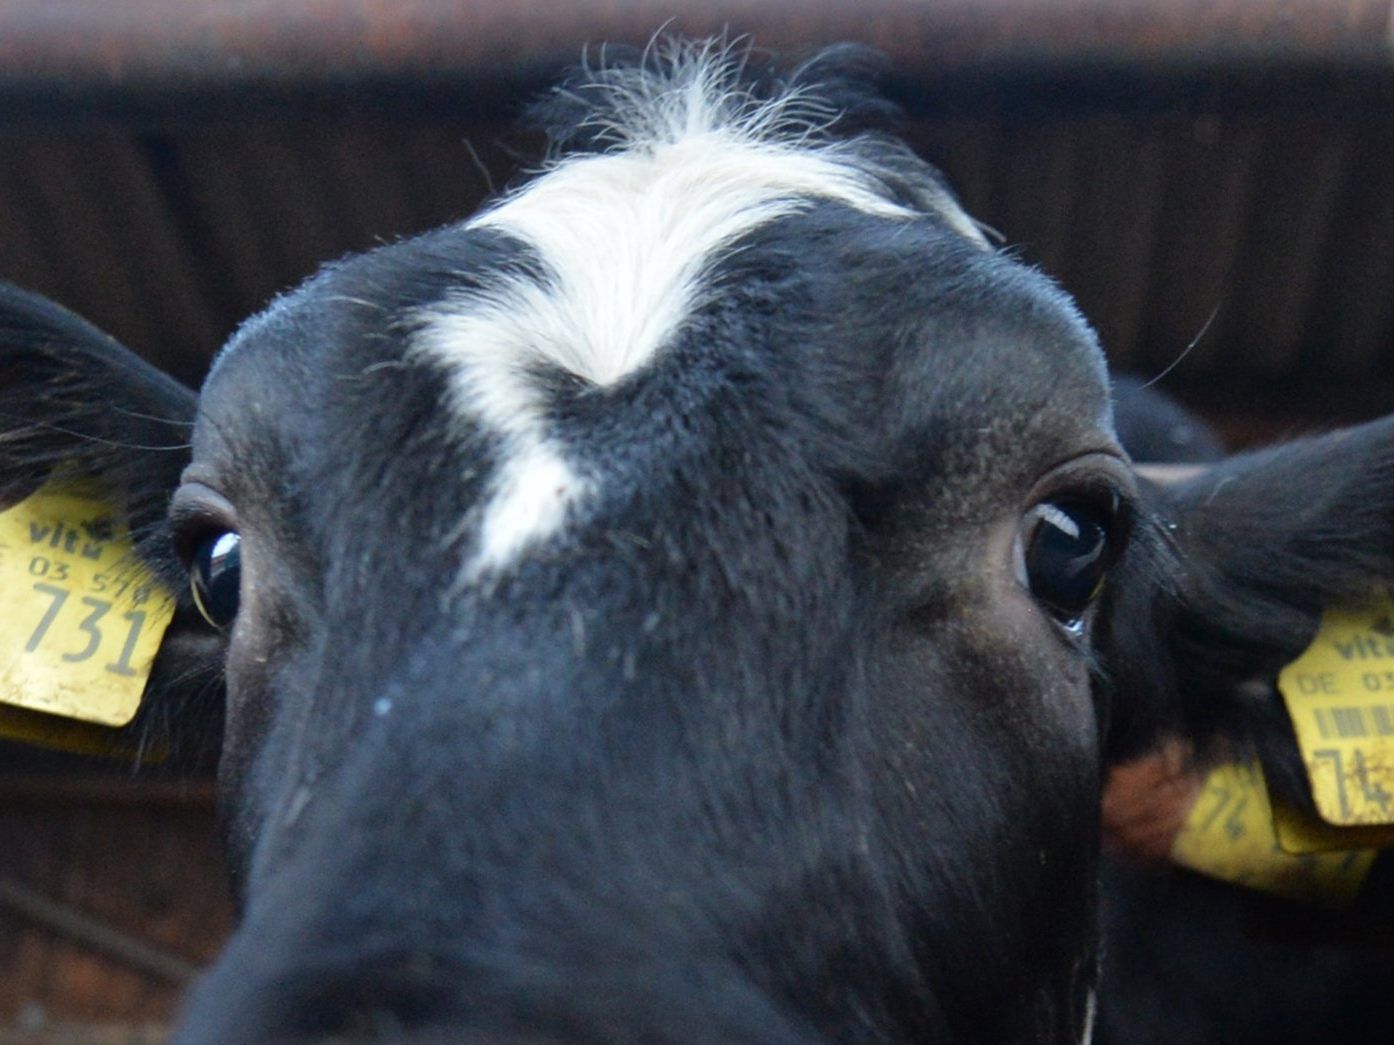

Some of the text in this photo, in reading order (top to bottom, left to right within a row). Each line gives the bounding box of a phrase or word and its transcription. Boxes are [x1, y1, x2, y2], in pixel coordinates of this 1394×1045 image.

[28, 555, 71, 582] 03
[24, 581, 147, 678] 731
[1297, 671, 1340, 696] DE
